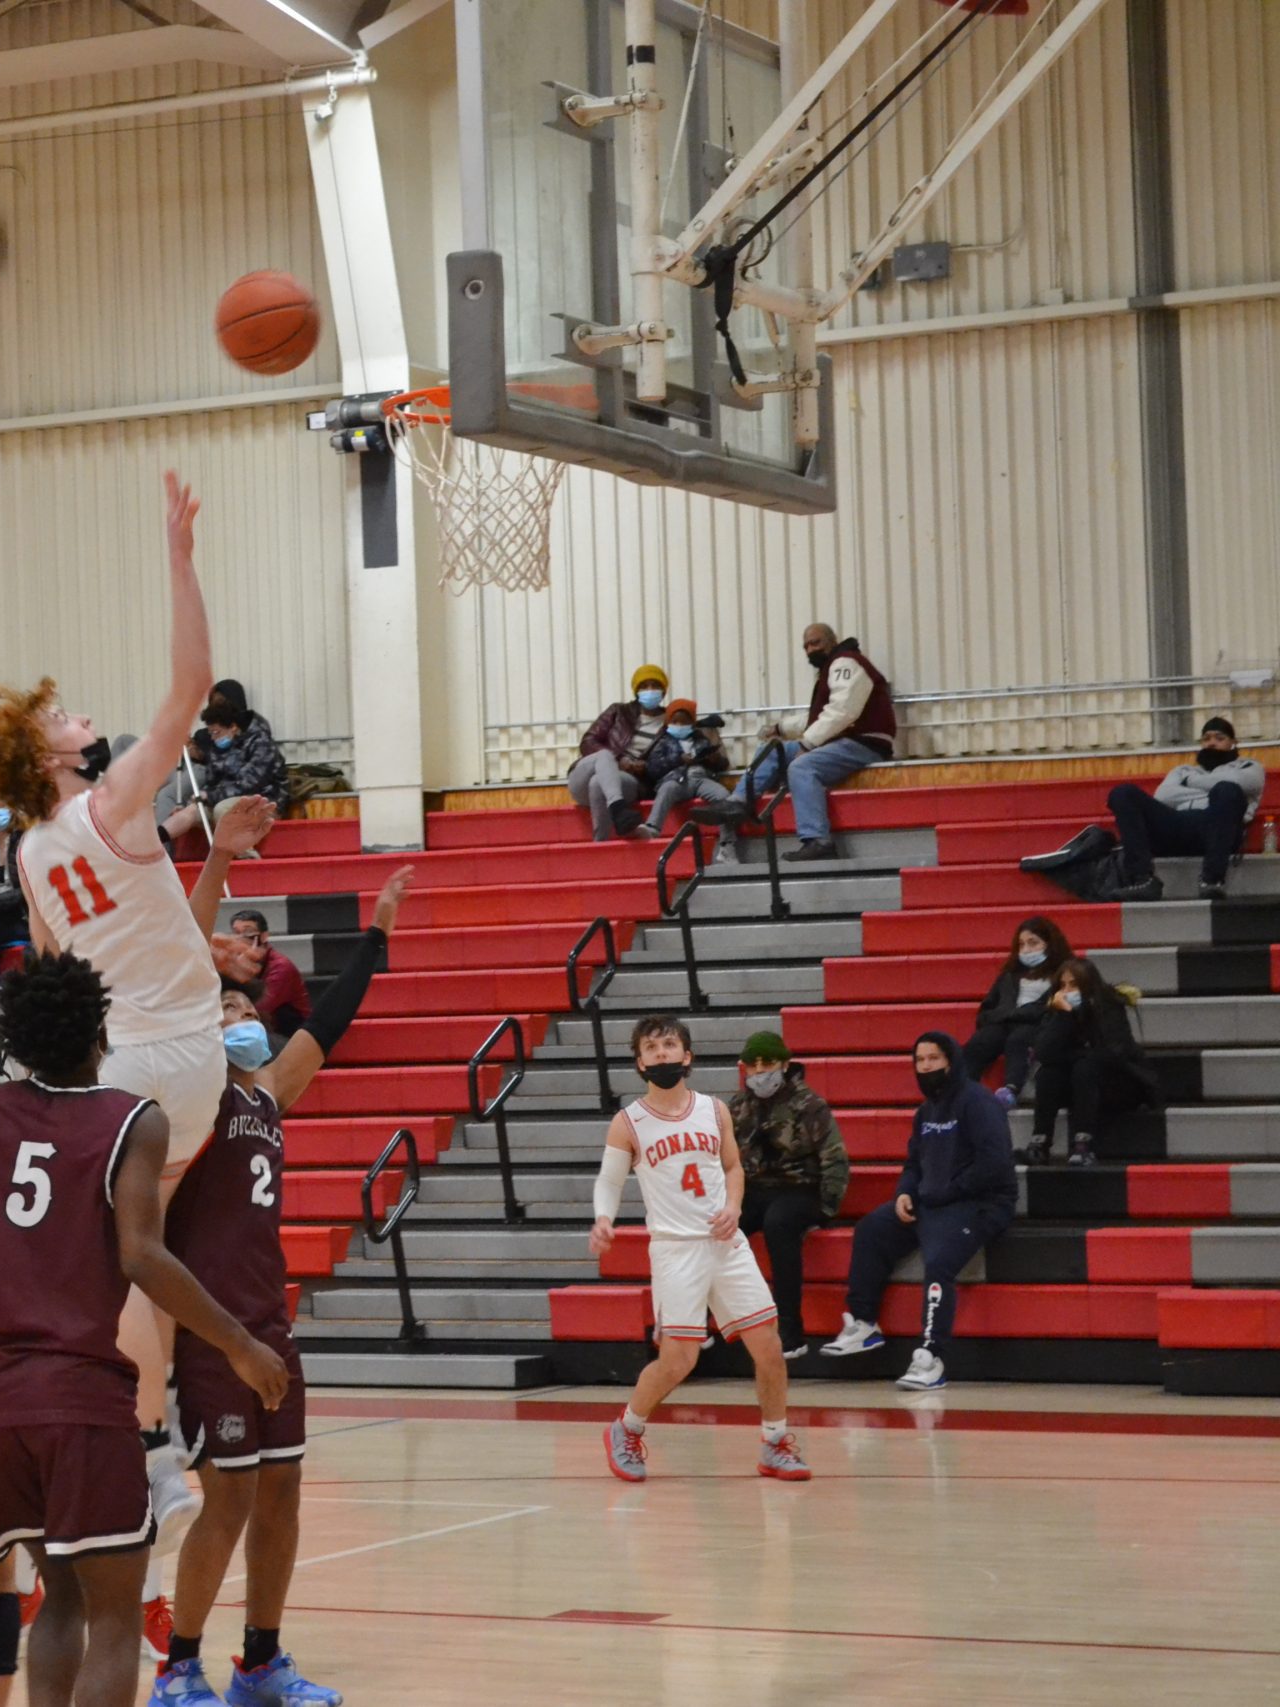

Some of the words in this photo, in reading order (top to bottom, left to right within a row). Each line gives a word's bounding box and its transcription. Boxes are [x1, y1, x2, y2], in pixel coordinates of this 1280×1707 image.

[834, 668, 851, 681] 70
[48, 855, 117, 928] 11
[646, 1132, 720, 1168] CONARD
[6, 1141, 57, 1228] 5
[250, 1154, 275, 1207] 2
[681, 1163, 706, 1198] 4
